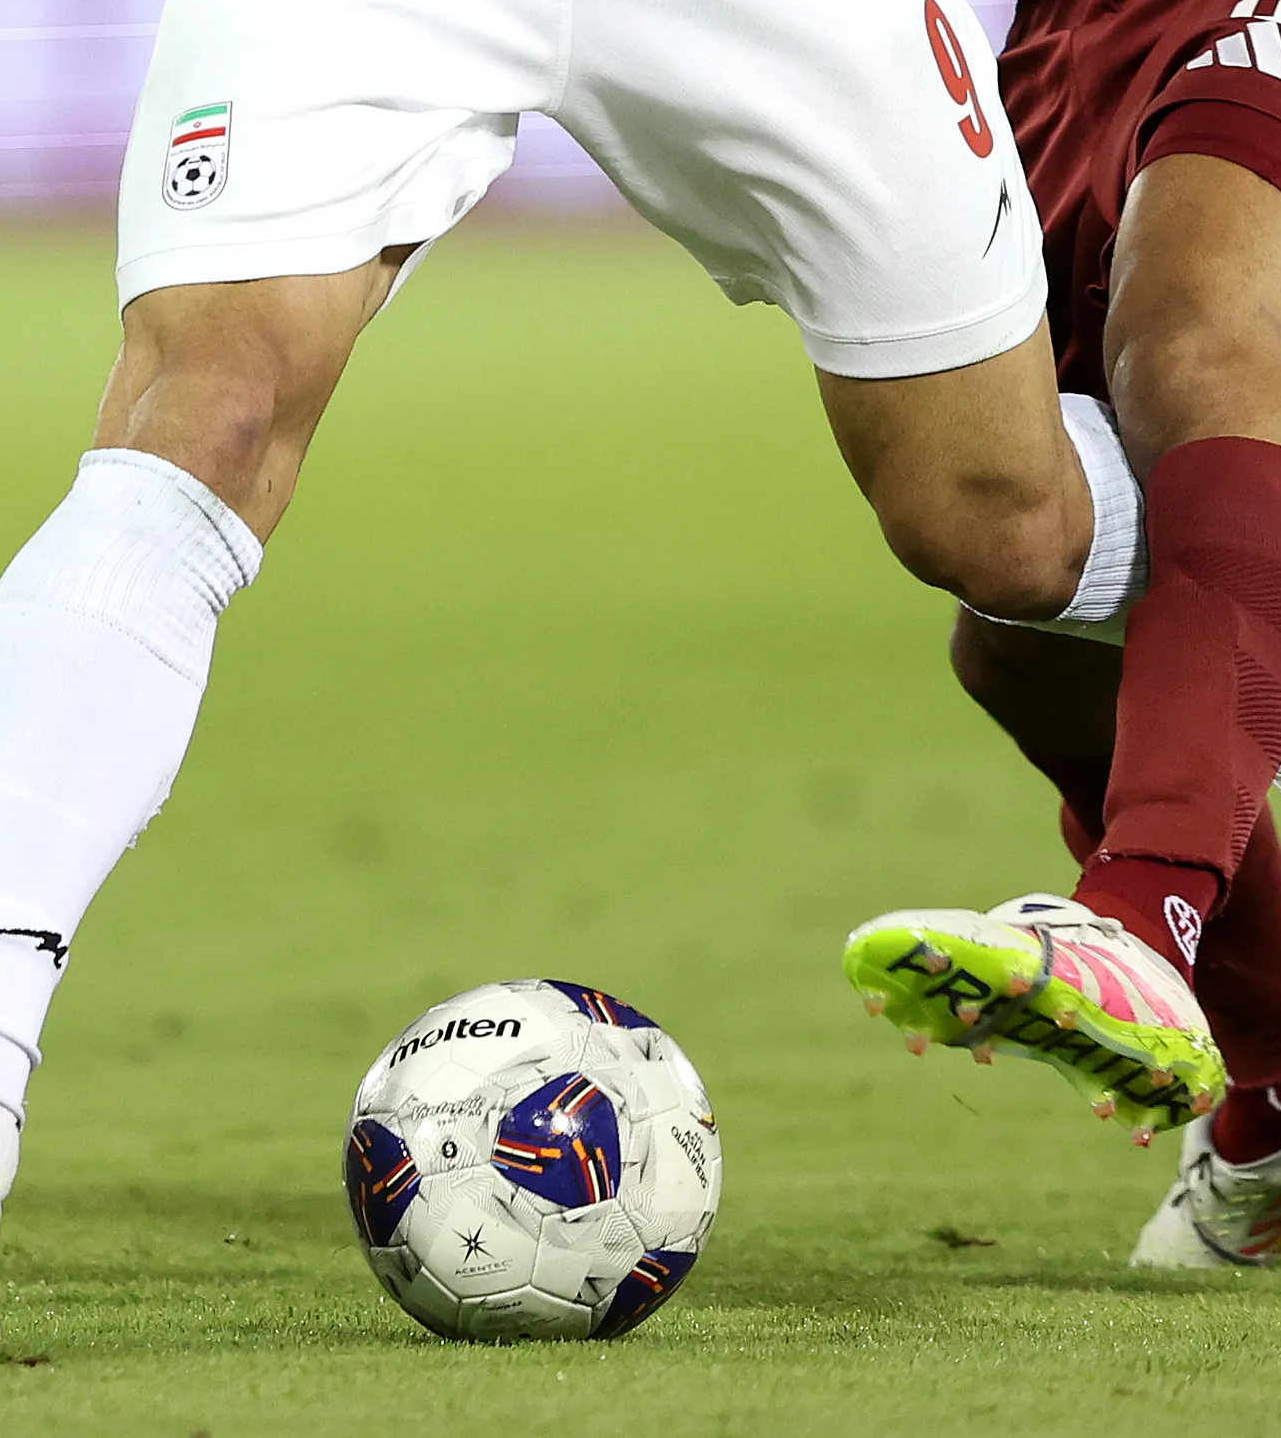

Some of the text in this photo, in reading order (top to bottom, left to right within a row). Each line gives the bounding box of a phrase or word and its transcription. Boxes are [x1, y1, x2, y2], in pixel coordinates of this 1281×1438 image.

[388, 1018, 522, 1070] molten
[670, 1126, 709, 1190] QUALIFIERS
[684, 1129, 706, 1166] ASIAN
